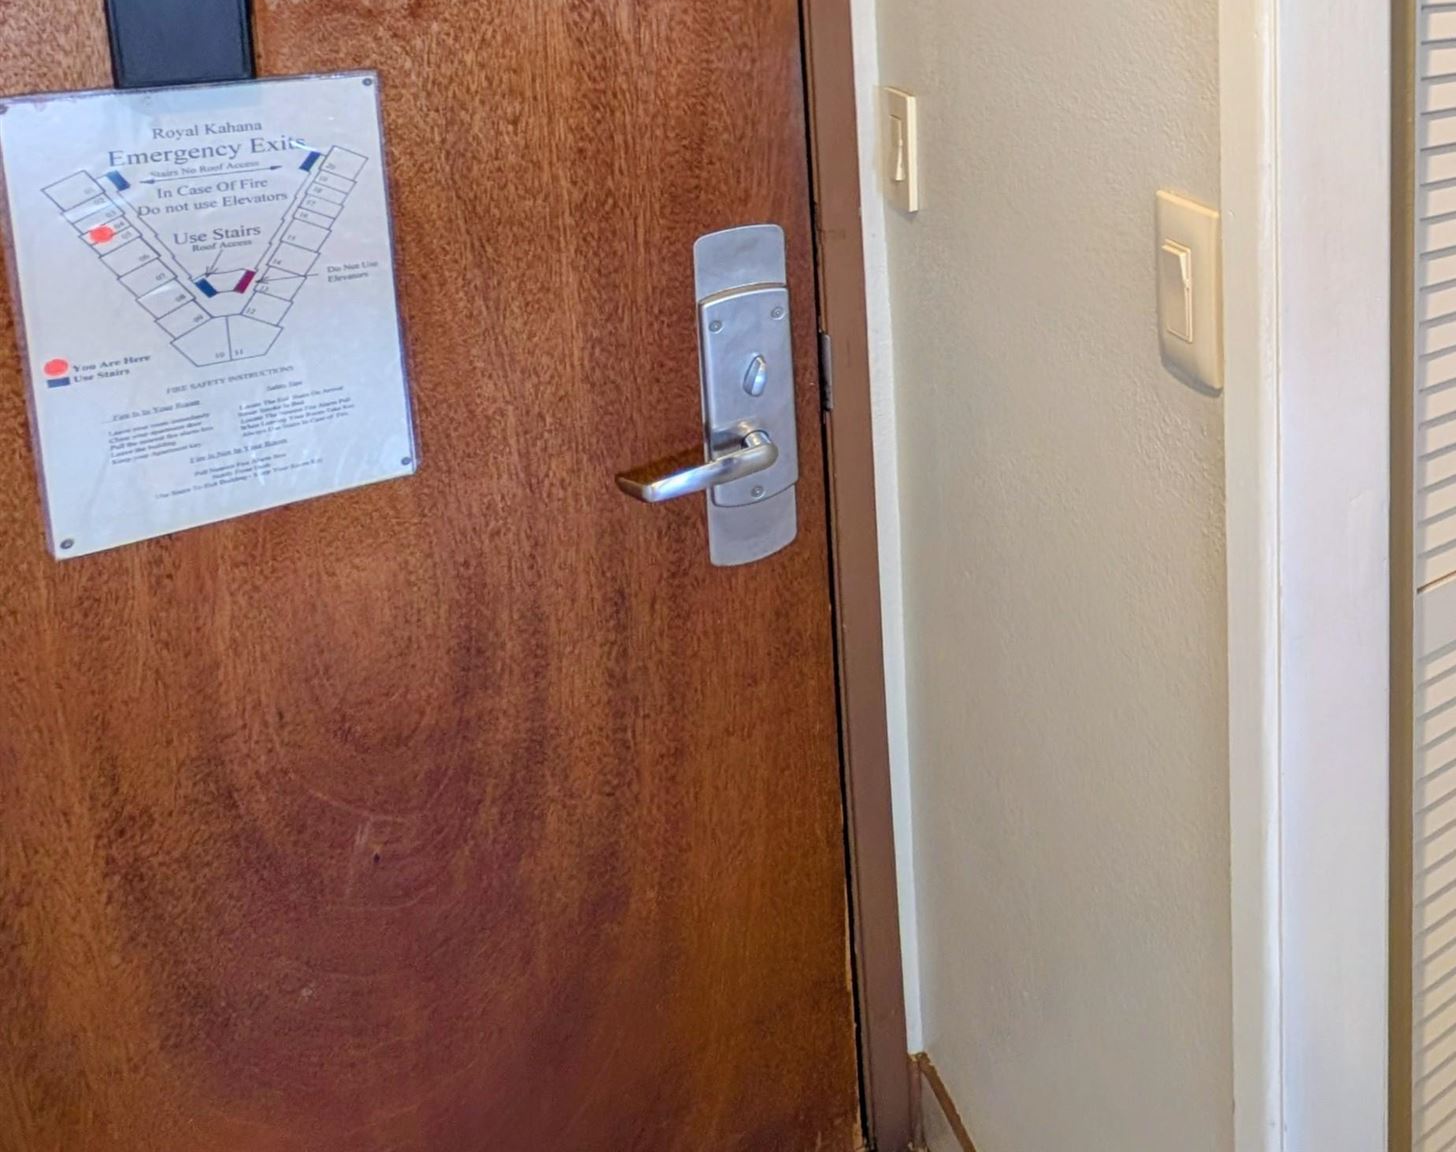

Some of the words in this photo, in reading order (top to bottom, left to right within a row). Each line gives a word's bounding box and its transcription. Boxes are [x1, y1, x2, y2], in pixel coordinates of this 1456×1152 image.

[153, 123, 199, 140] Royal
[205, 121, 263, 136] Kahana
[108, 142, 243, 168] Emergency
[250, 136, 307, 153] Exits
[150, 169, 180, 178] Stairs
[181, 167, 197, 176] No
[199, 164, 224, 174] Roof
[225, 160, 260, 171] Access
[157, 187, 173, 199] In
[177, 183, 214, 197] Case
[217, 179, 237, 192] Of
[240, 176, 269, 189] Fire
[137, 205, 160, 217] Do
[165, 201, 191, 214] not
[194, 199, 219, 210] use
[222, 191, 289, 208] Elevators
[173, 232, 208, 246] Use
[212, 224, 262, 242] Stairs
[73, 363, 97, 373] You
[100, 358, 121, 368] Are
[124, 354, 152, 365] Here
[74, 374, 94, 383] Use
[97, 368, 130, 379] Stairs
[166, 383, 188, 394] FIRE
[190, 377, 225, 391] SAFETY
[228, 365, 294, 383] INSTRUCTIONS
